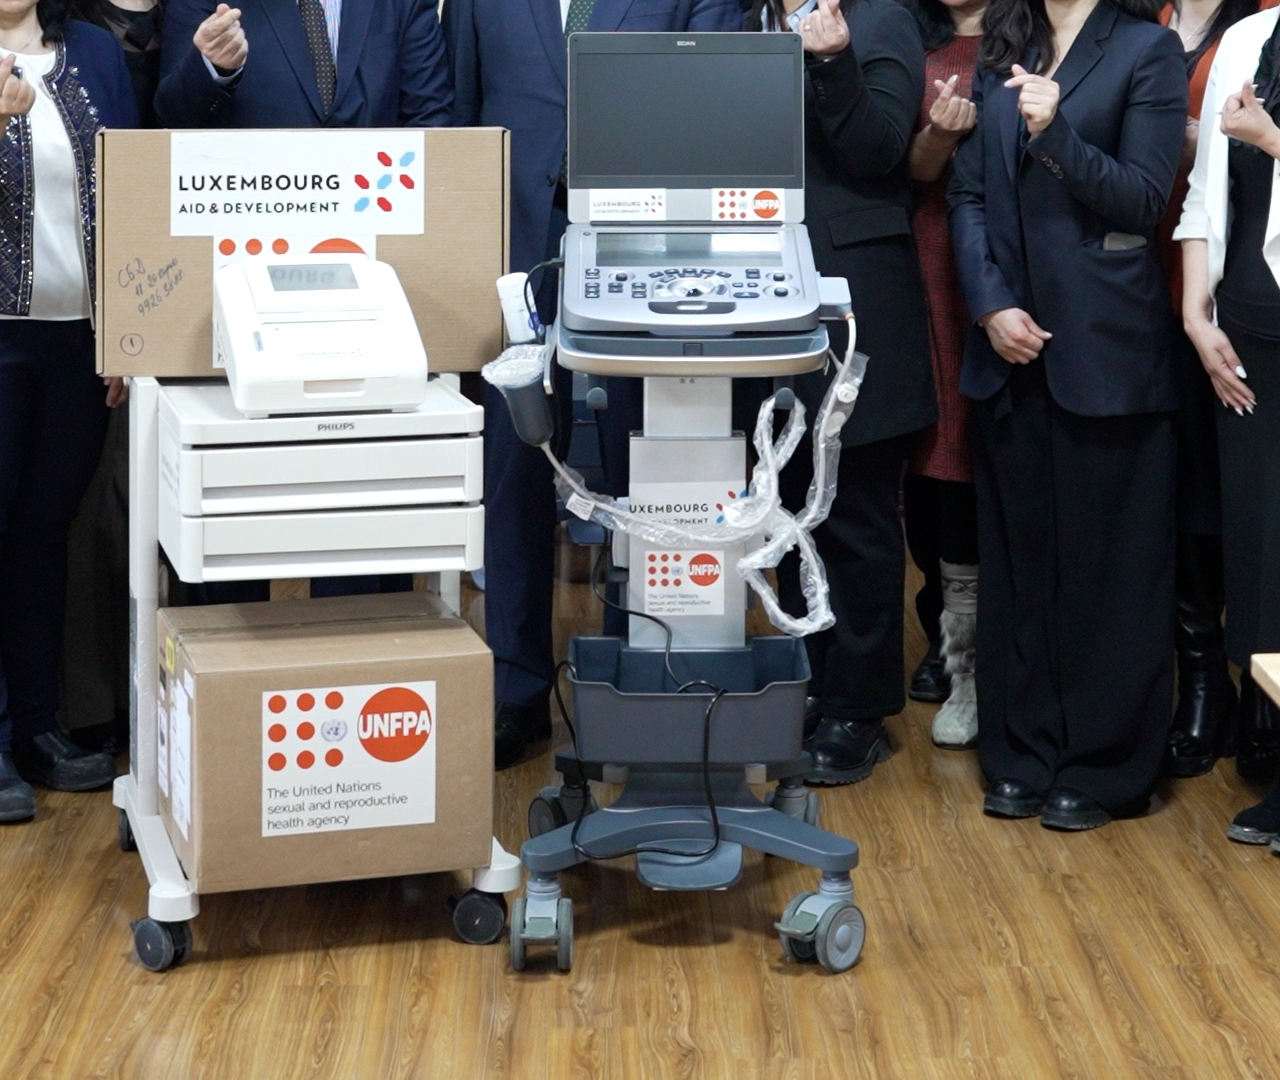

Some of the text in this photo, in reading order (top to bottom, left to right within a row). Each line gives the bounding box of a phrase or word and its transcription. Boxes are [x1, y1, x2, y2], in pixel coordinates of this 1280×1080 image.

[179, 174, 340, 191] LUXEMBOURG
[179, 201, 340, 214] AID & DEVELOPMENT
[752, 199, 781, 210] UNFPA
[317, 422, 355, 432] PHILIPS
[629, 503, 709, 513] UXEMBOURG
[688, 563, 720, 577] UNFPA
[358, 710, 431, 740] UNFPA
[267, 781, 381, 799] The United Nations
[267, 793, 408, 814] sexual and reproductive
[267, 814, 350, 830] health agency
